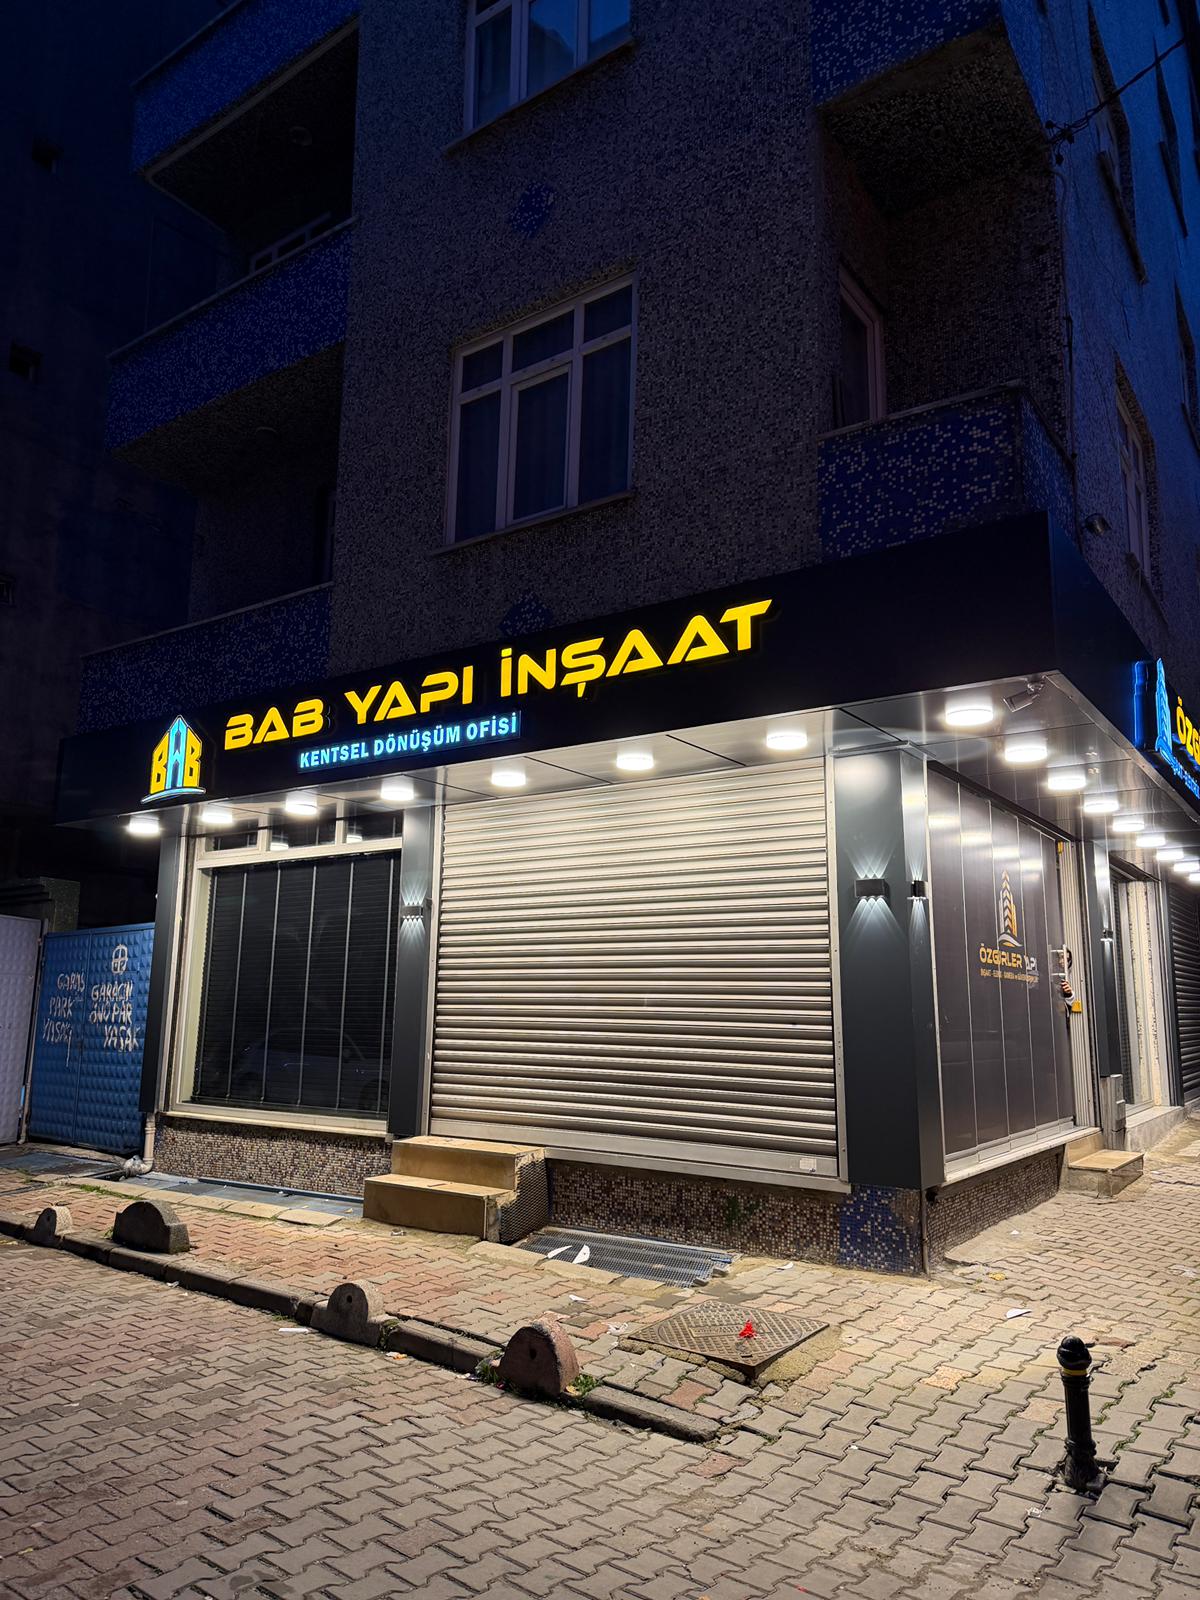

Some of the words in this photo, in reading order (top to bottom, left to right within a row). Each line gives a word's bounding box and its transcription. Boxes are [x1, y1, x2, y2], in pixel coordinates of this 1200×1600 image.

[225, 700, 323, 750] BAB
[345, 666, 473, 724] YAPI
[501, 600, 771, 698] İNŞAAT
[299, 742, 369, 768] KENTSEL
[374, 725, 460, 752] DÖNÜŞÜM
[466, 712, 517, 740] OFİSİ
[1176, 696, 1200, 767] ÖZG
[103, 1024, 141, 1053] YASAK
